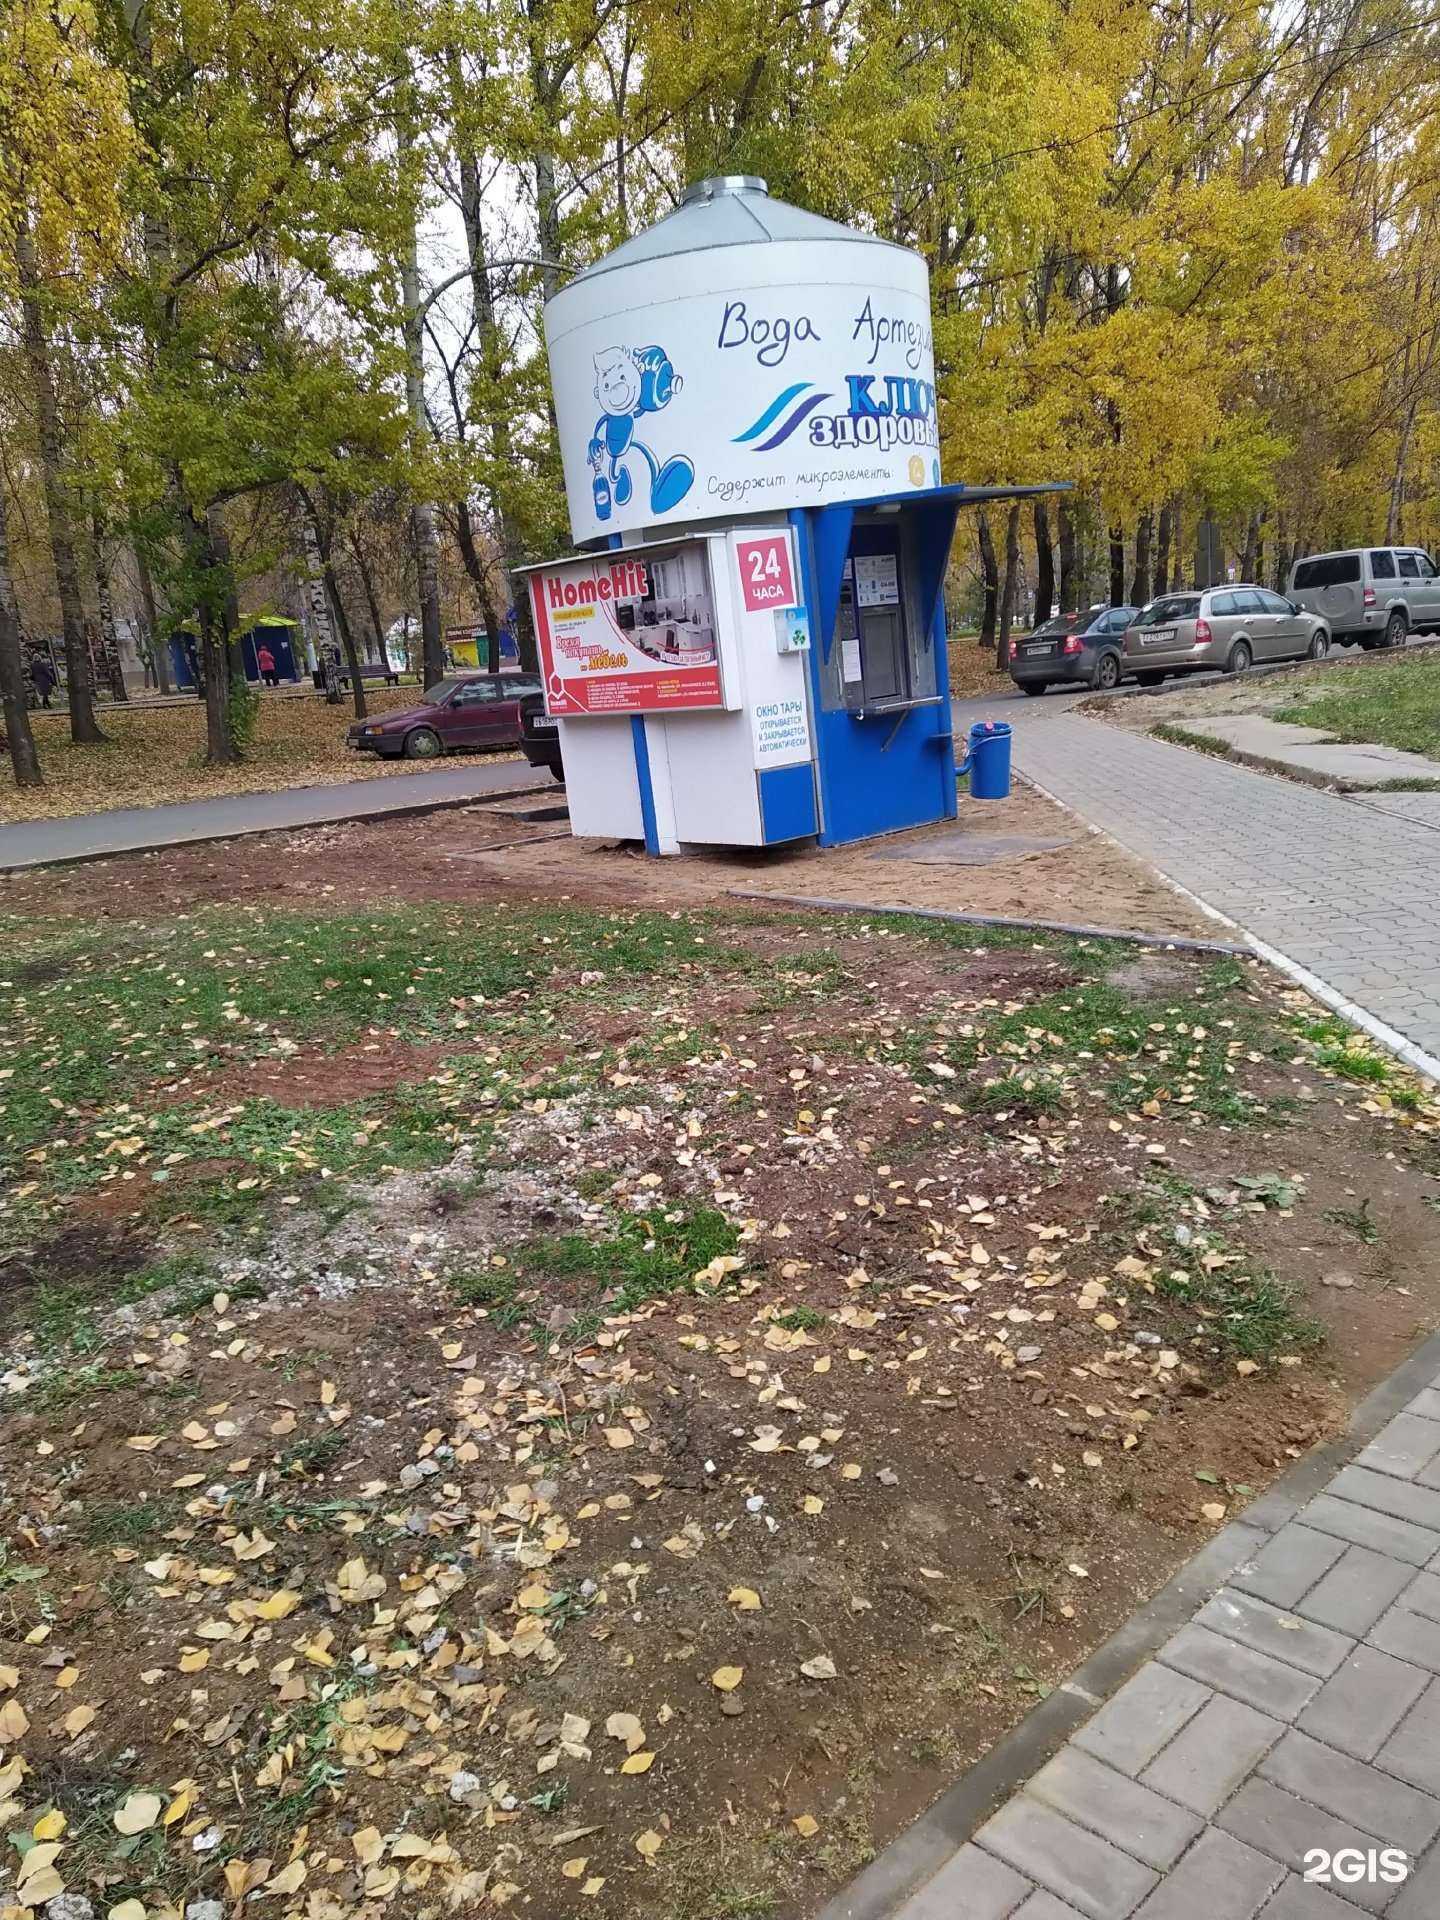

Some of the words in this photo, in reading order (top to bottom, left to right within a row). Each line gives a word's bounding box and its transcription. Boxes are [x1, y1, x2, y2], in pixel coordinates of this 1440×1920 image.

[718, 301, 821, 367] Вода
[809, 415, 939, 452] здоровь
[707, 475, 786, 502] Содержит
[748, 547, 781, 582] 24
[548, 560, 647, 608] HomeHit
[752, 584, 784, 600] ЧАСА
[756, 704, 779, 718] ОКНО
[780, 701, 803, 714] ТАРЫ
[760, 716, 802, 730] ОТКРЫВАЕТСЯ
[764, 726, 806, 741] ЗАКРЫВАЕТСЯ
[759, 738, 807, 753] АВТОМАТИЧЕСКИ
